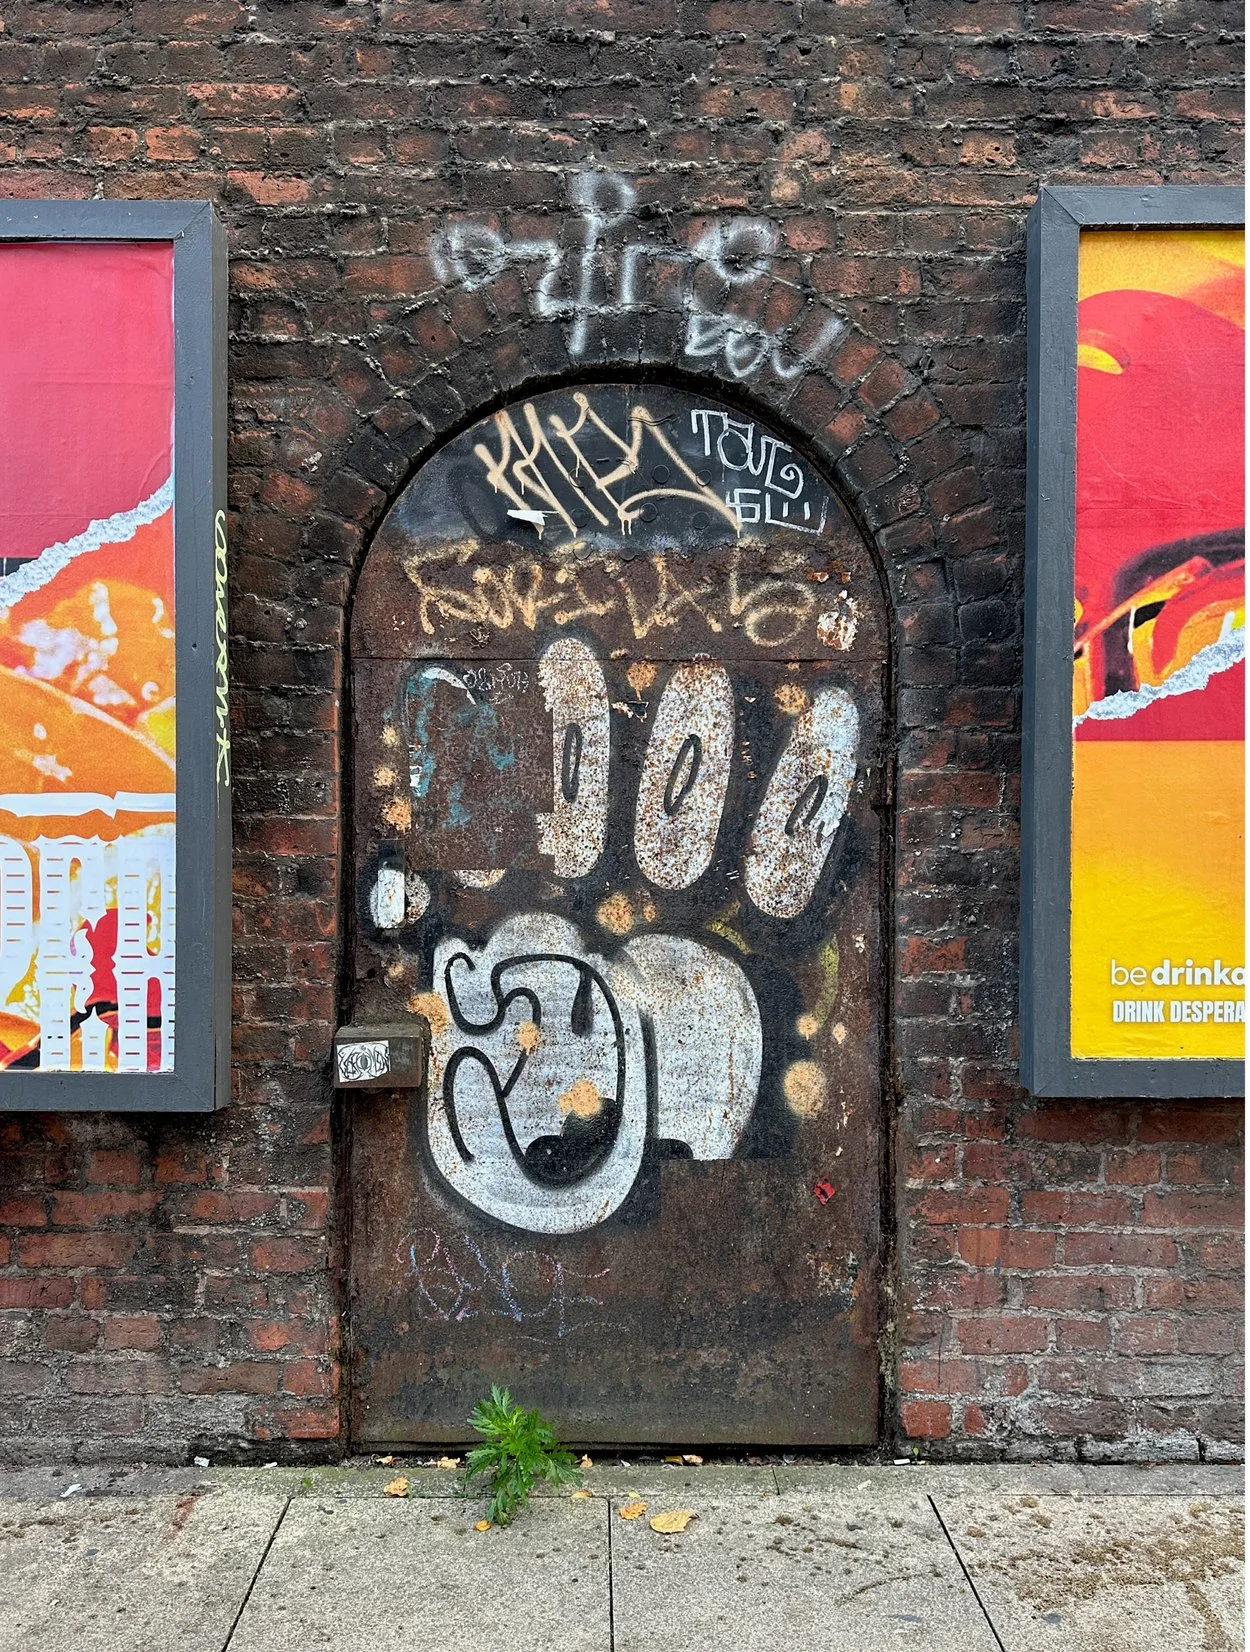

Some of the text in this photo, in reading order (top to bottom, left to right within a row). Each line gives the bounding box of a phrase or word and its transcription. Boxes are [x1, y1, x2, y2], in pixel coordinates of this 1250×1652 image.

[1111, 959, 1147, 985] be
[1113, 1000, 1245, 1023] DRINK DESPERA
